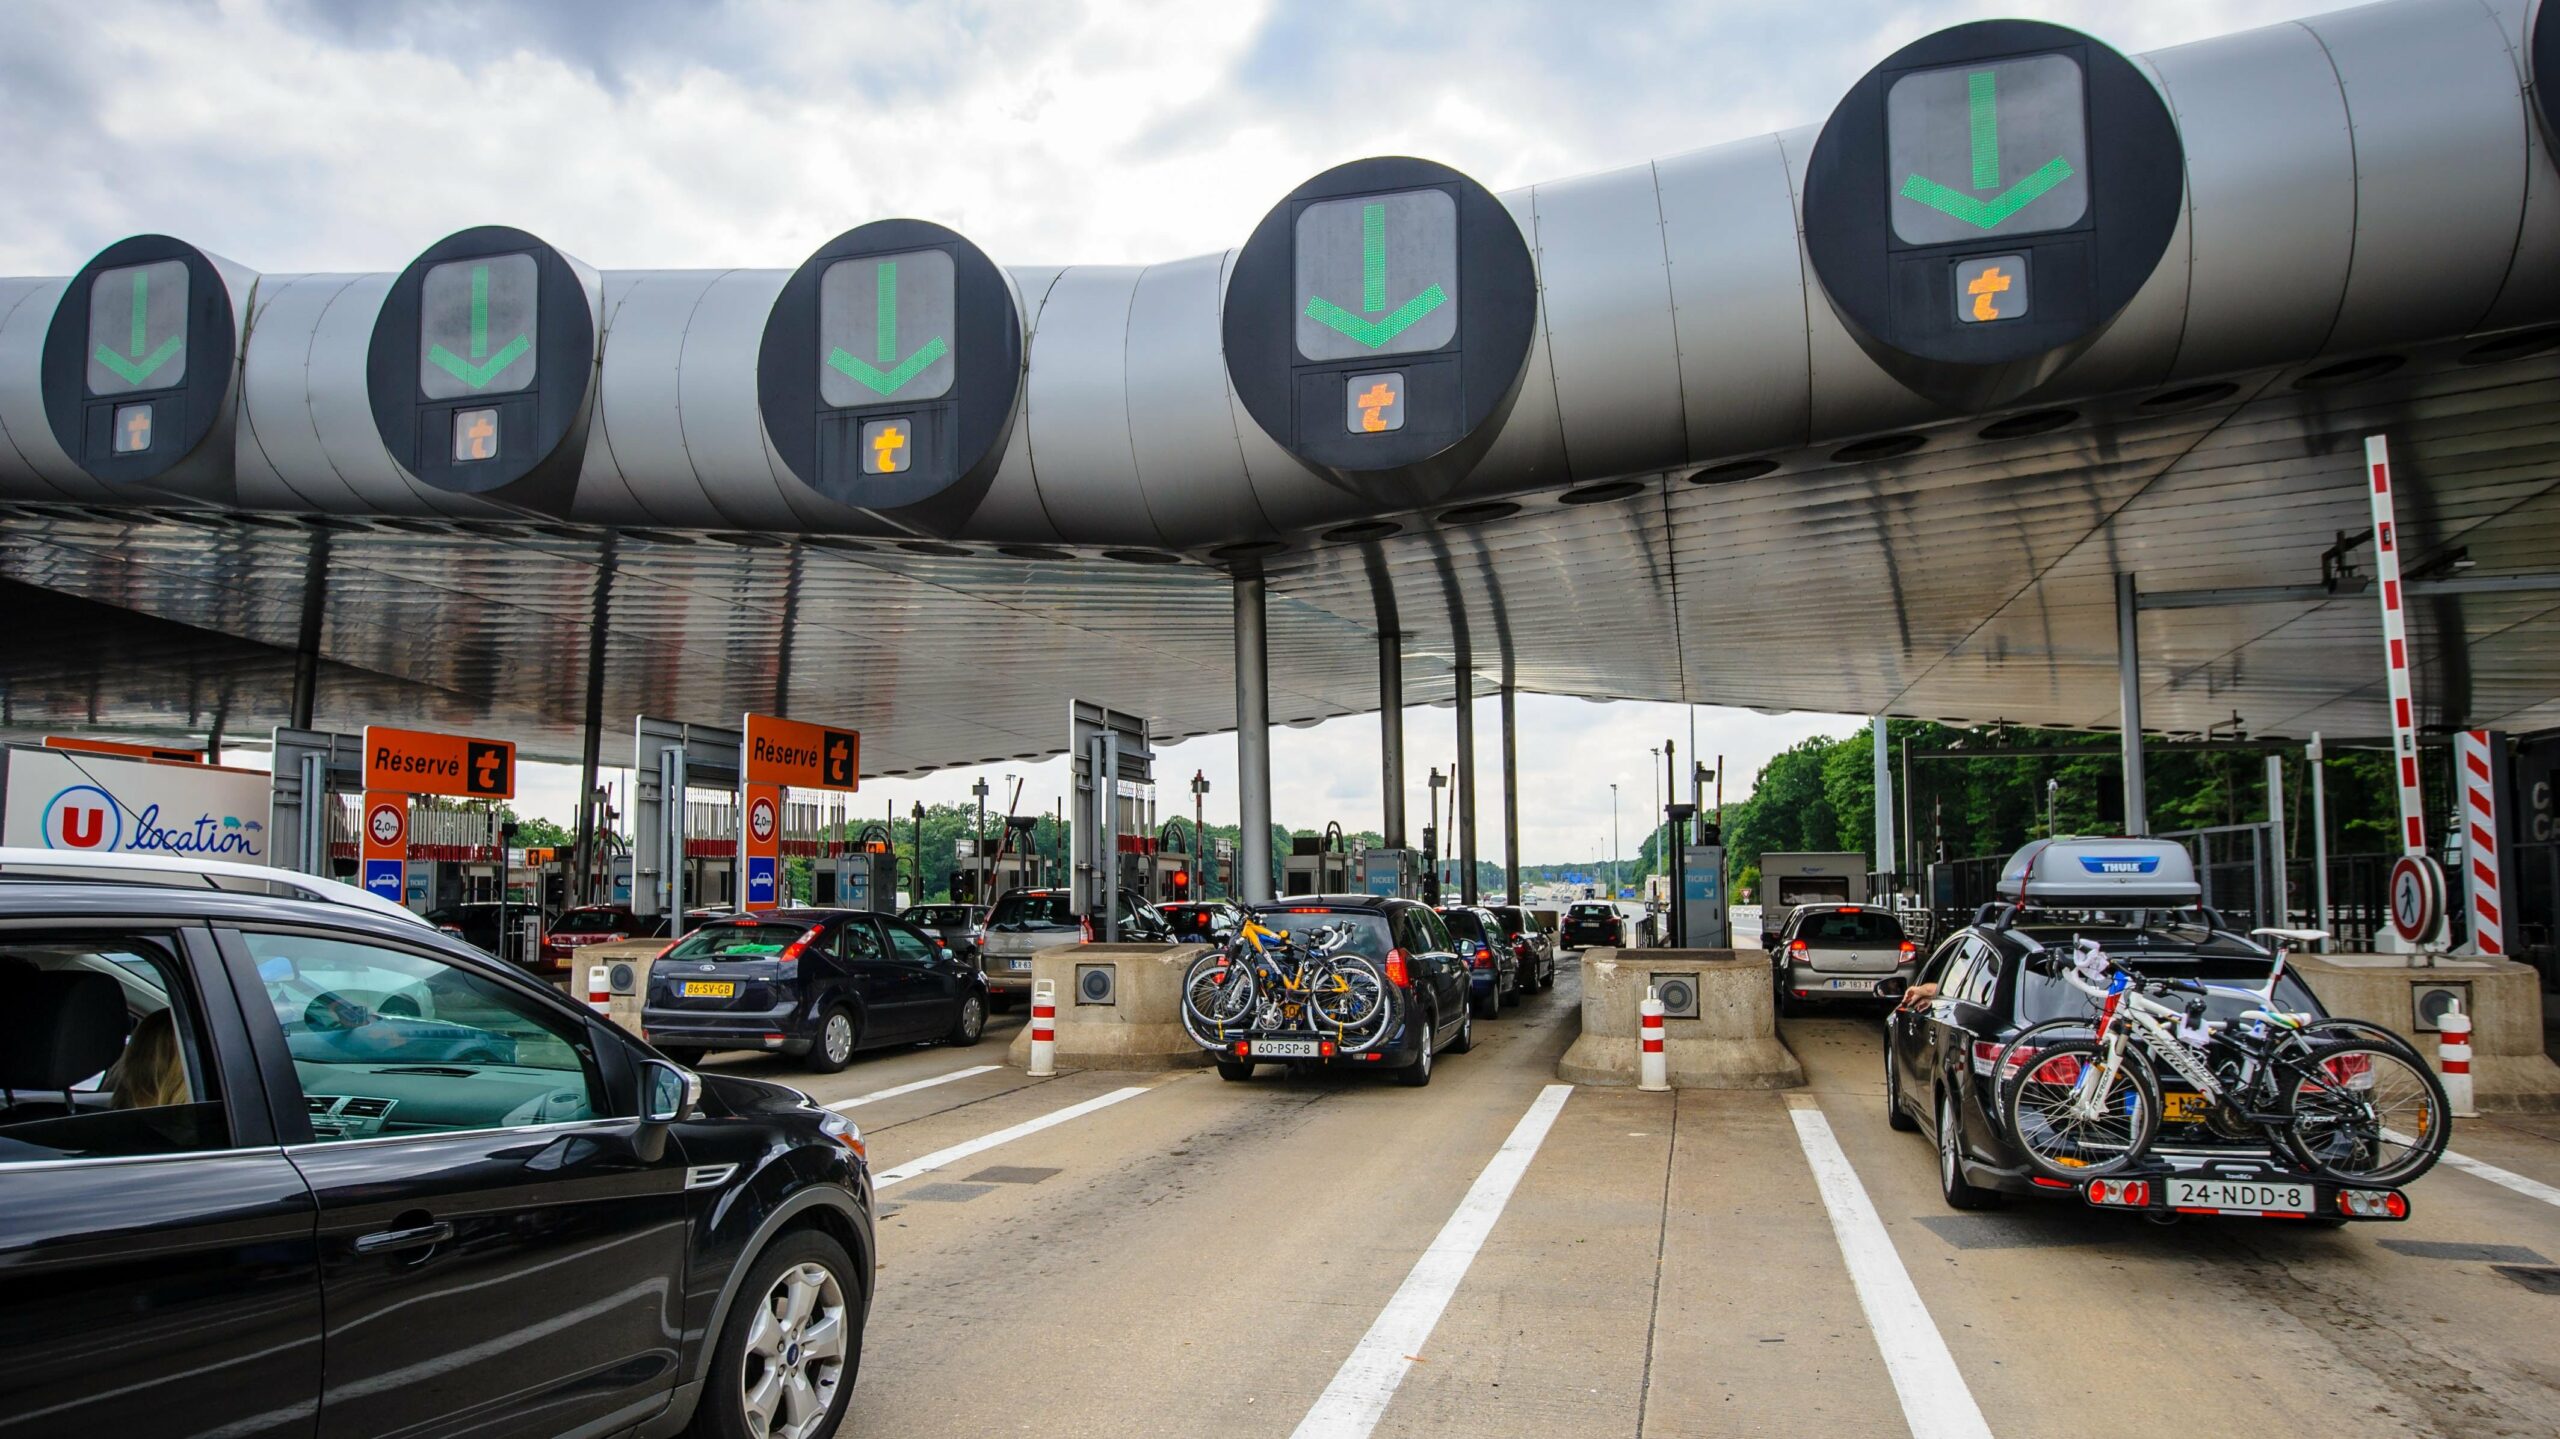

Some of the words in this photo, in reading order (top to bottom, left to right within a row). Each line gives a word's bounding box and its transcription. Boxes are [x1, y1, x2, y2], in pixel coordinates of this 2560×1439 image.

[1967, 266, 2012, 321] t
[1358, 383, 1395, 432] t
[128, 413, 149, 450] t
[468, 417, 493, 459] t
[874, 427, 905, 472] t
[375, 747, 460, 776] Réservé
[475, 750, 500, 788] t
[754, 737, 818, 768] Réservé
[829, 739, 849, 780] t
[62, 806, 104, 848] U
[125, 803, 262, 856] location
[2102, 863, 2140, 872] THULE
[687, 983, 731, 994] 86-SV-GB
[1258, 1043, 1311, 1054] 60-PSP-8
[2180, 1183, 2302, 1207] 24-NDD-8
